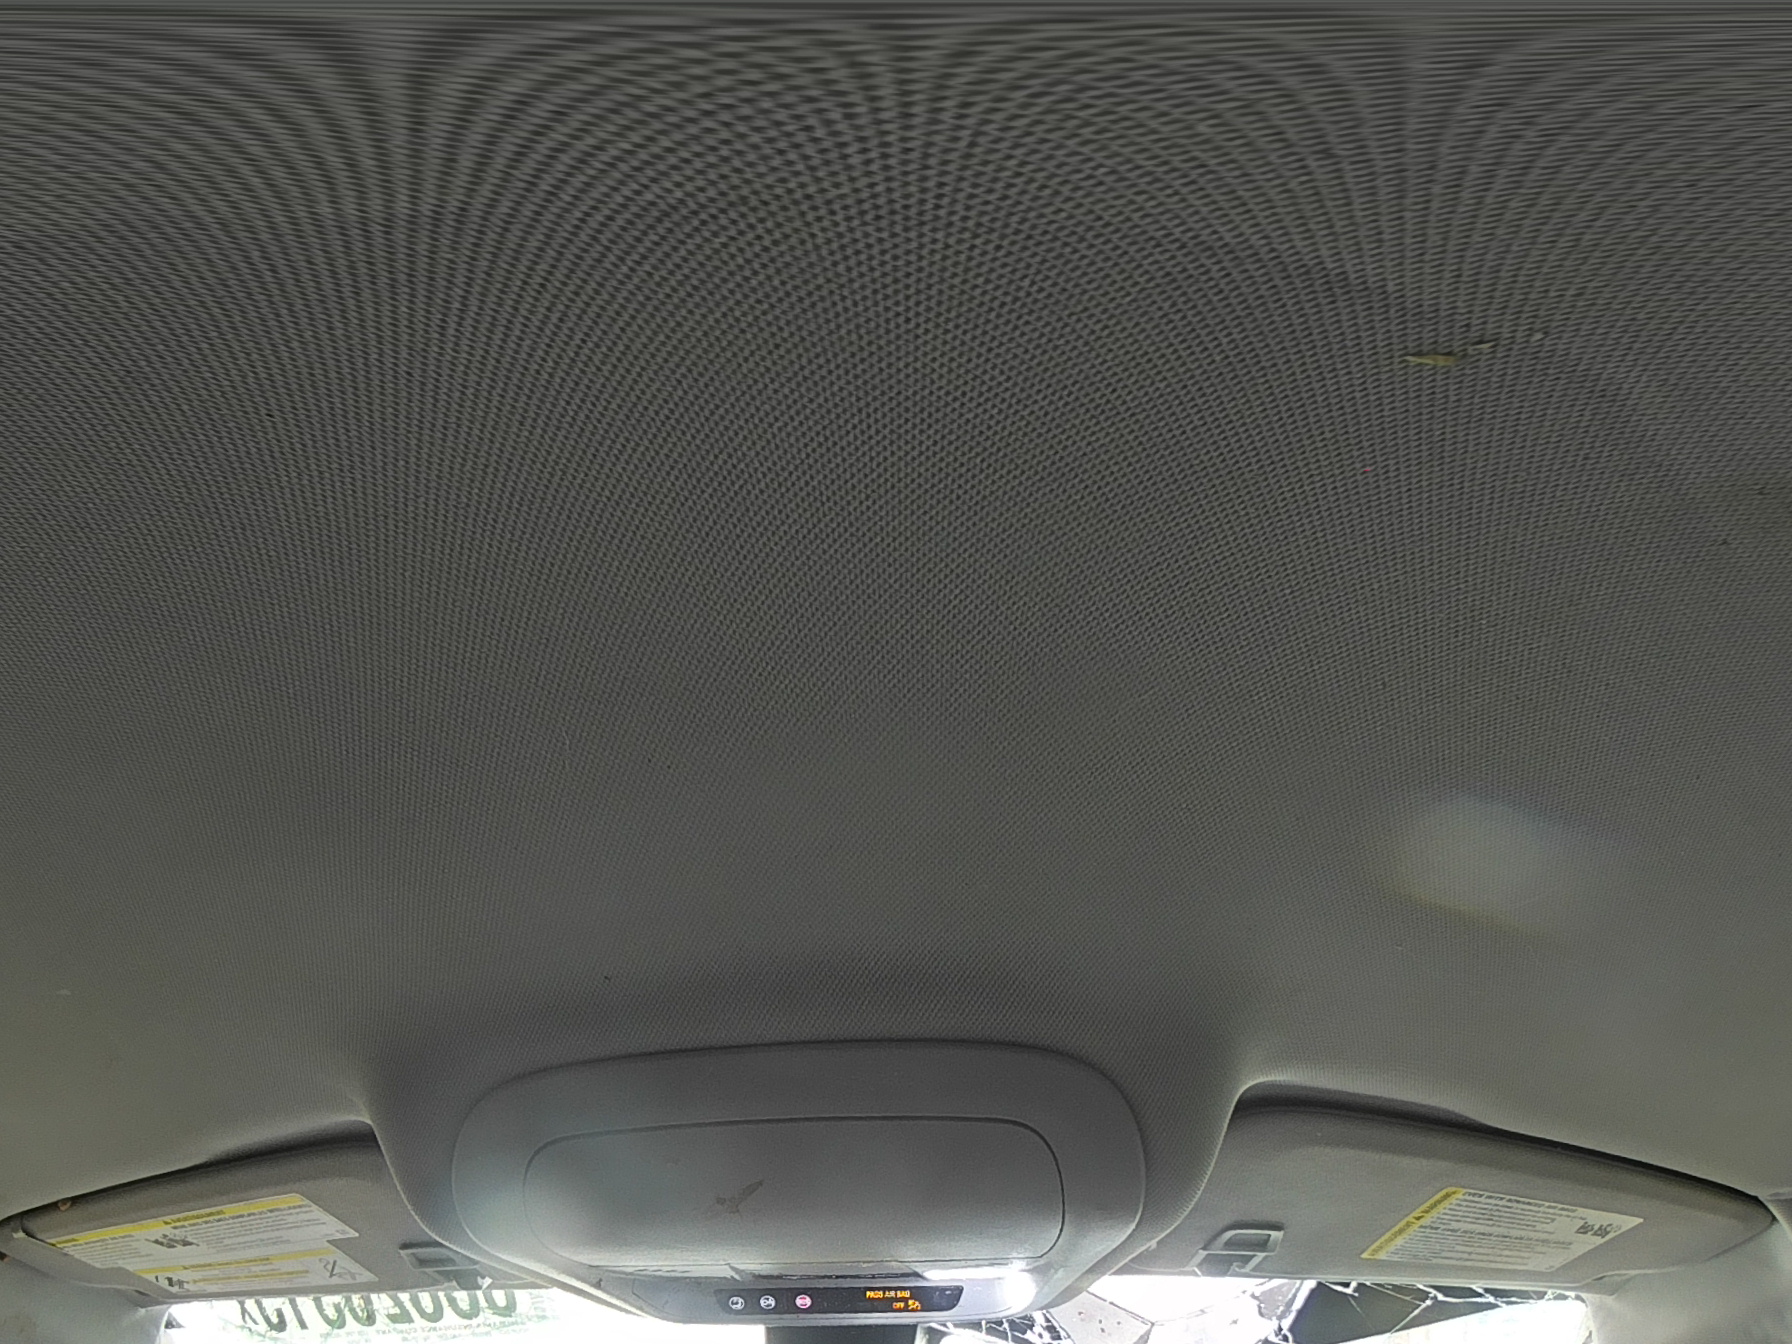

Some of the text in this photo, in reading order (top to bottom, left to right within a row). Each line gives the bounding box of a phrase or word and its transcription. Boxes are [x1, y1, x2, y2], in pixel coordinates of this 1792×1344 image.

[884, 1290, 895, 1298] AIR
[896, 1290, 910, 1298] BAG
[892, 1301, 905, 1309] OFF
